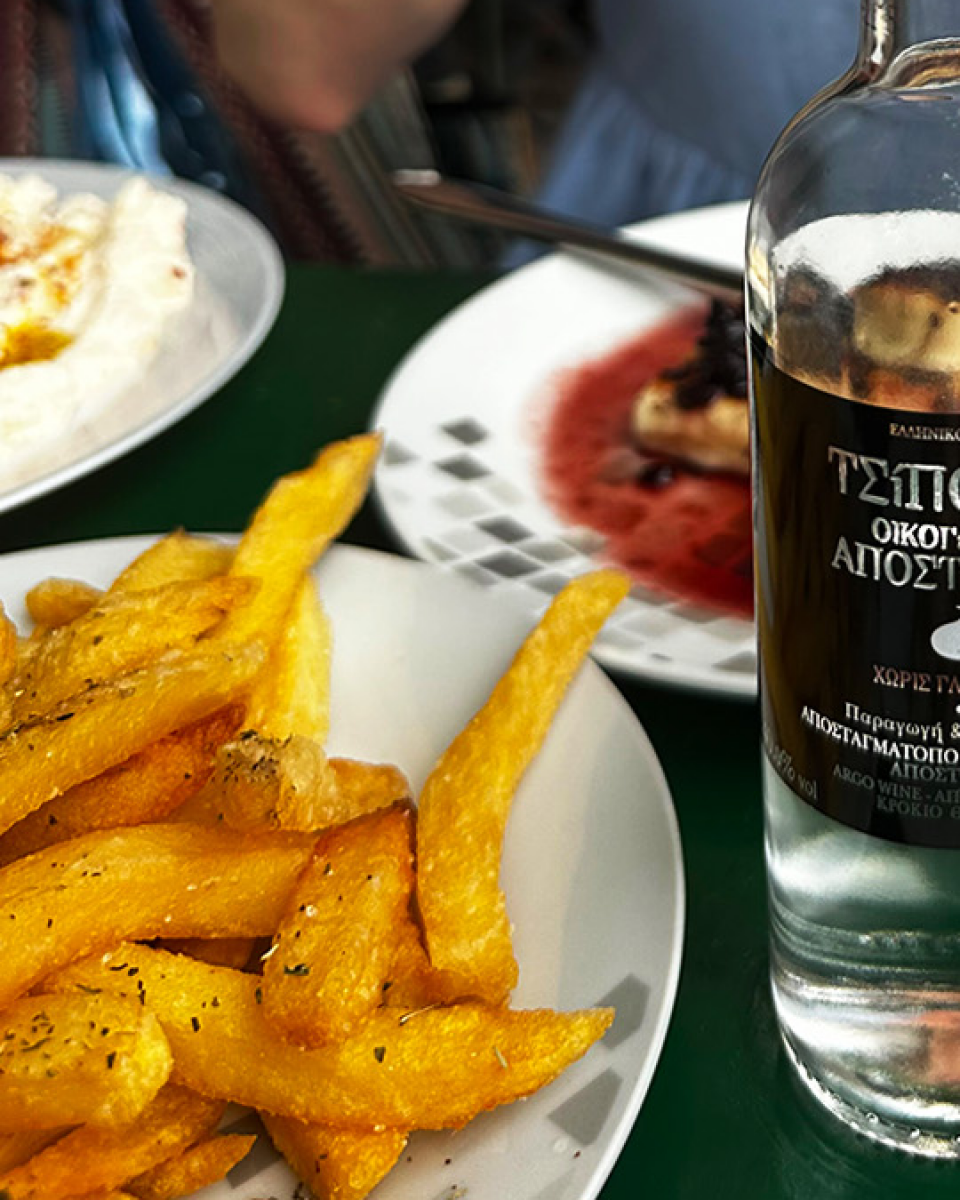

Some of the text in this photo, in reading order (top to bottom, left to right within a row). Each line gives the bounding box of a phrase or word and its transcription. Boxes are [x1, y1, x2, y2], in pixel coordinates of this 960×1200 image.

[872, 664, 932, 693] ΧΩΡΙΣ
[845, 701, 944, 744] Παραγωγή
[877, 779, 925, 801] WINE
